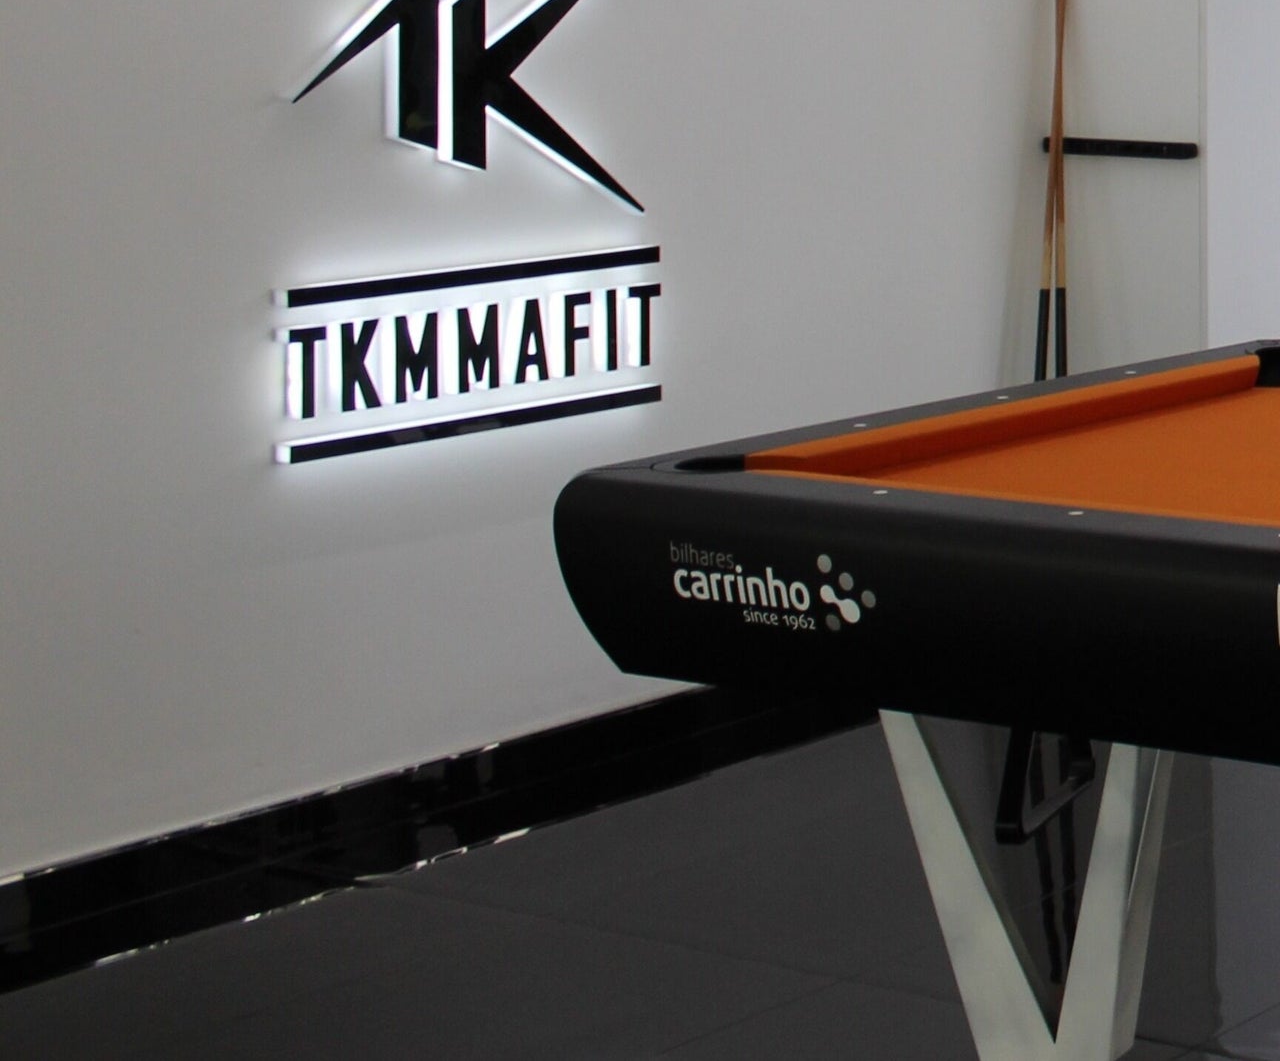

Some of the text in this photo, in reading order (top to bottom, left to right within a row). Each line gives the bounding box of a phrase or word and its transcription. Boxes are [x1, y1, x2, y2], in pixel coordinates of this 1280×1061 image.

[280, 283, 662, 419] TKMMAFIT
[670, 540, 735, 570] bilhares
[673, 564, 811, 611] carrinho
[743, 607, 816, 630] since 1962
